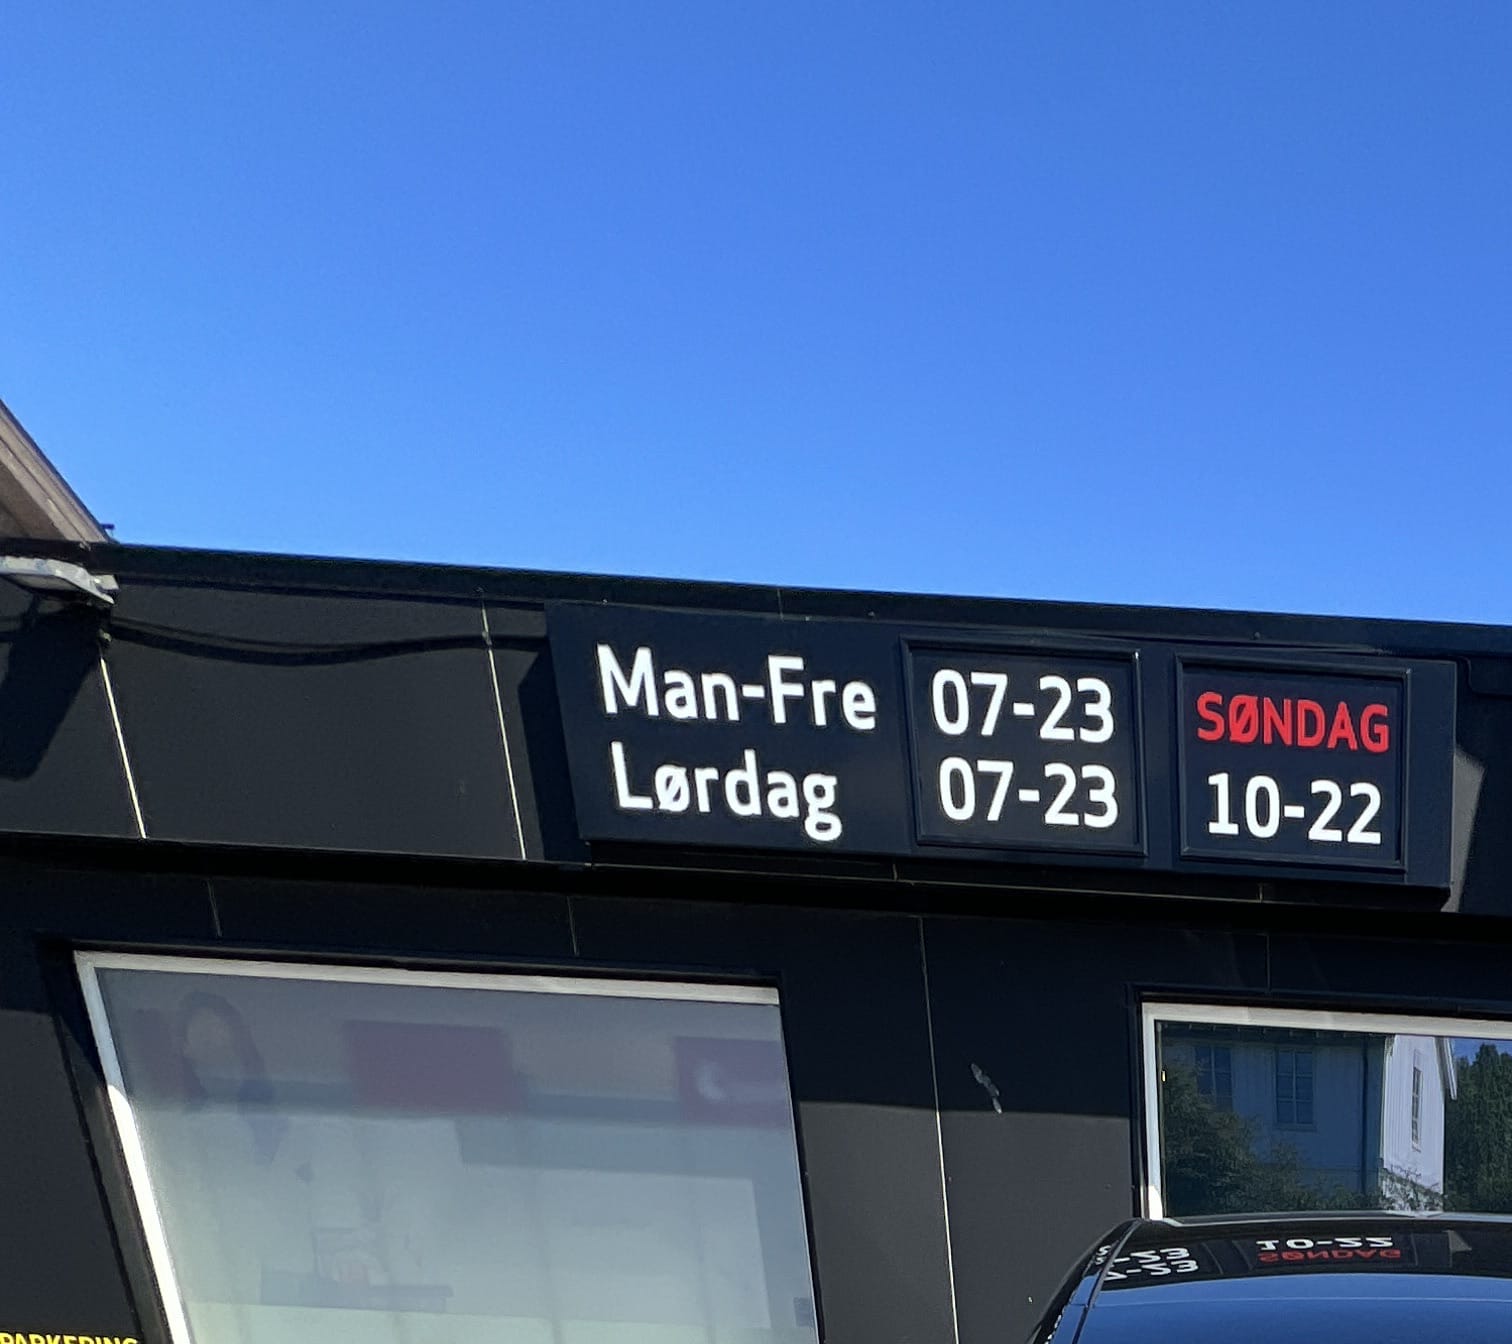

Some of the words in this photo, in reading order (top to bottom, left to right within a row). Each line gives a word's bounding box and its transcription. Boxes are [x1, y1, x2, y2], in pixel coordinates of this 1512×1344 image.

[597, 643, 877, 731] Man-Fre
[931, 667, 1115, 744] 07-23
[1196, 691, 1391, 754] SØNDAG
[610, 741, 843, 842] Lørdag
[937, 756, 1120, 829] 07-23
[1208, 772, 1383, 846] 10-22
